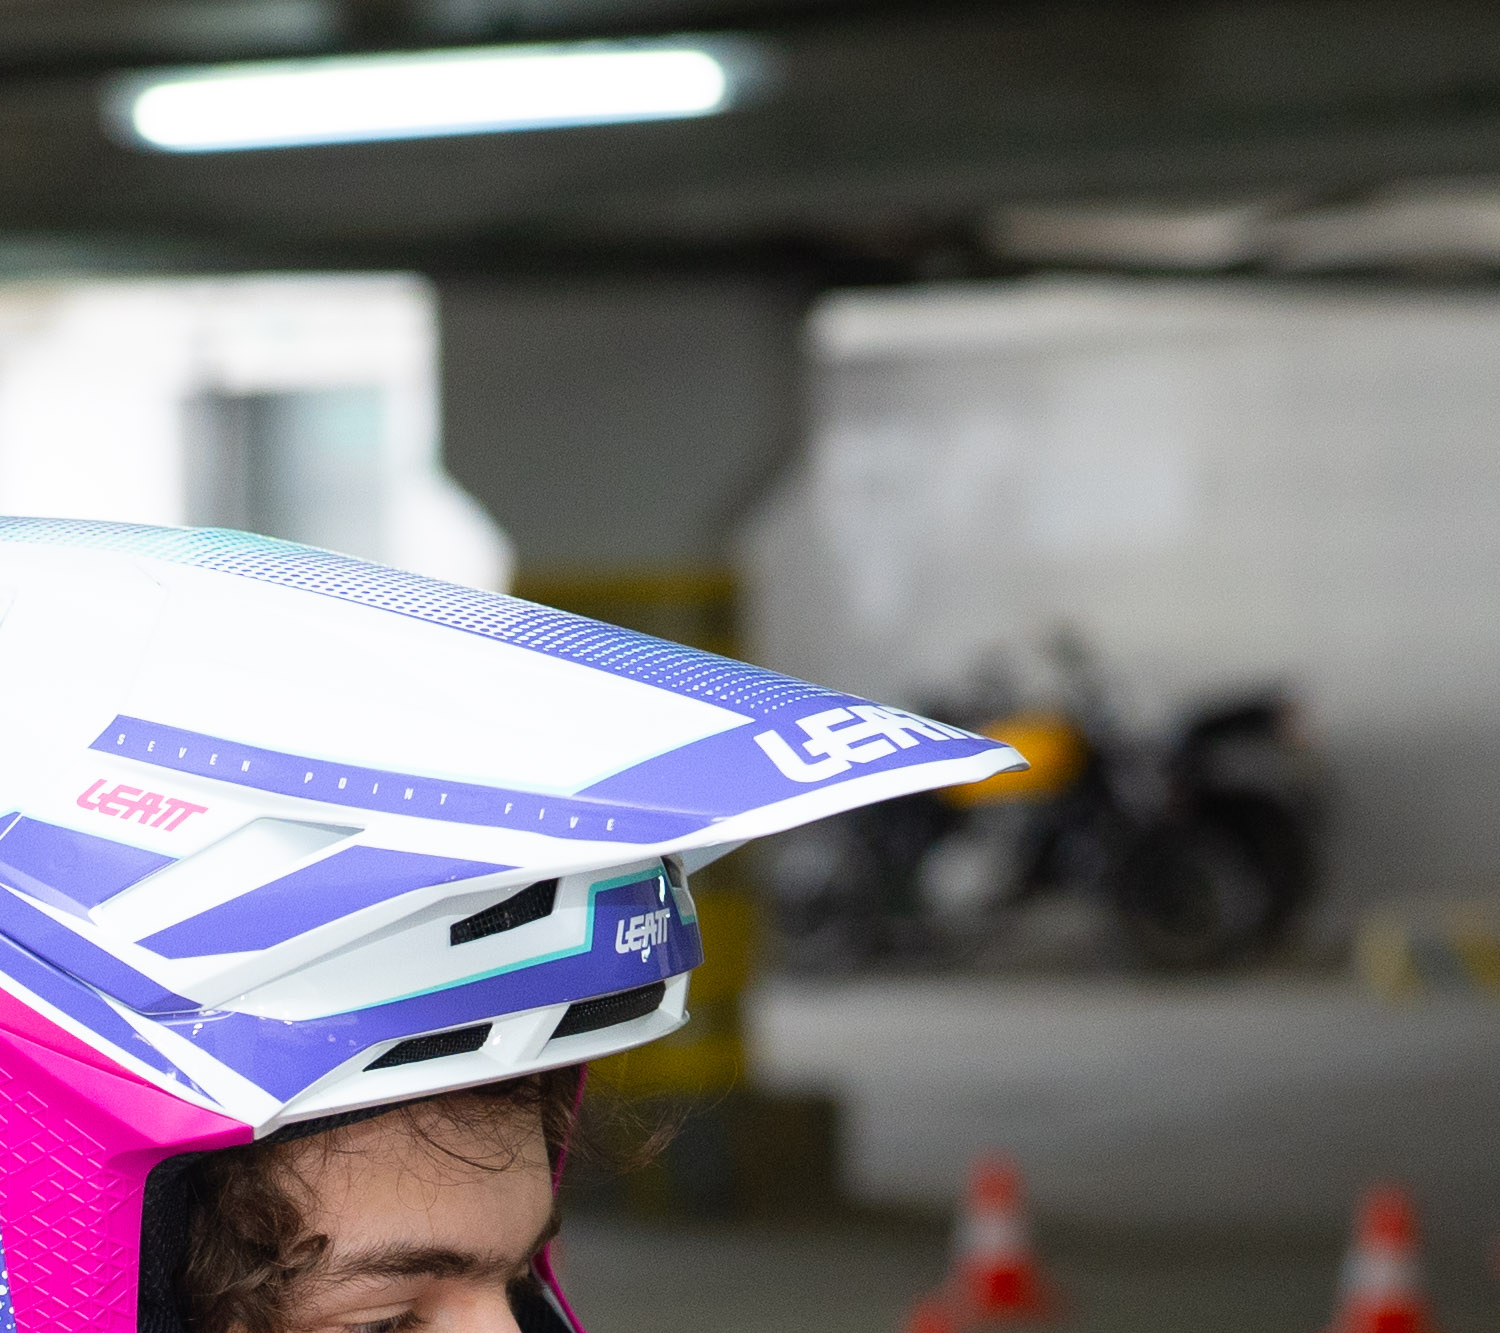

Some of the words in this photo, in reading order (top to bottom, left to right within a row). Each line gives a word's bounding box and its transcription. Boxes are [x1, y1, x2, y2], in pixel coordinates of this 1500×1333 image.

[753, 704, 985, 783] LEATT
[76, 777, 209, 833] LEATT
[116, 731, 252, 773] SEVEN
[304, 771, 450, 806] POINT
[504, 802, 616, 832] FIVE
[614, 906, 671, 956] LEATT
